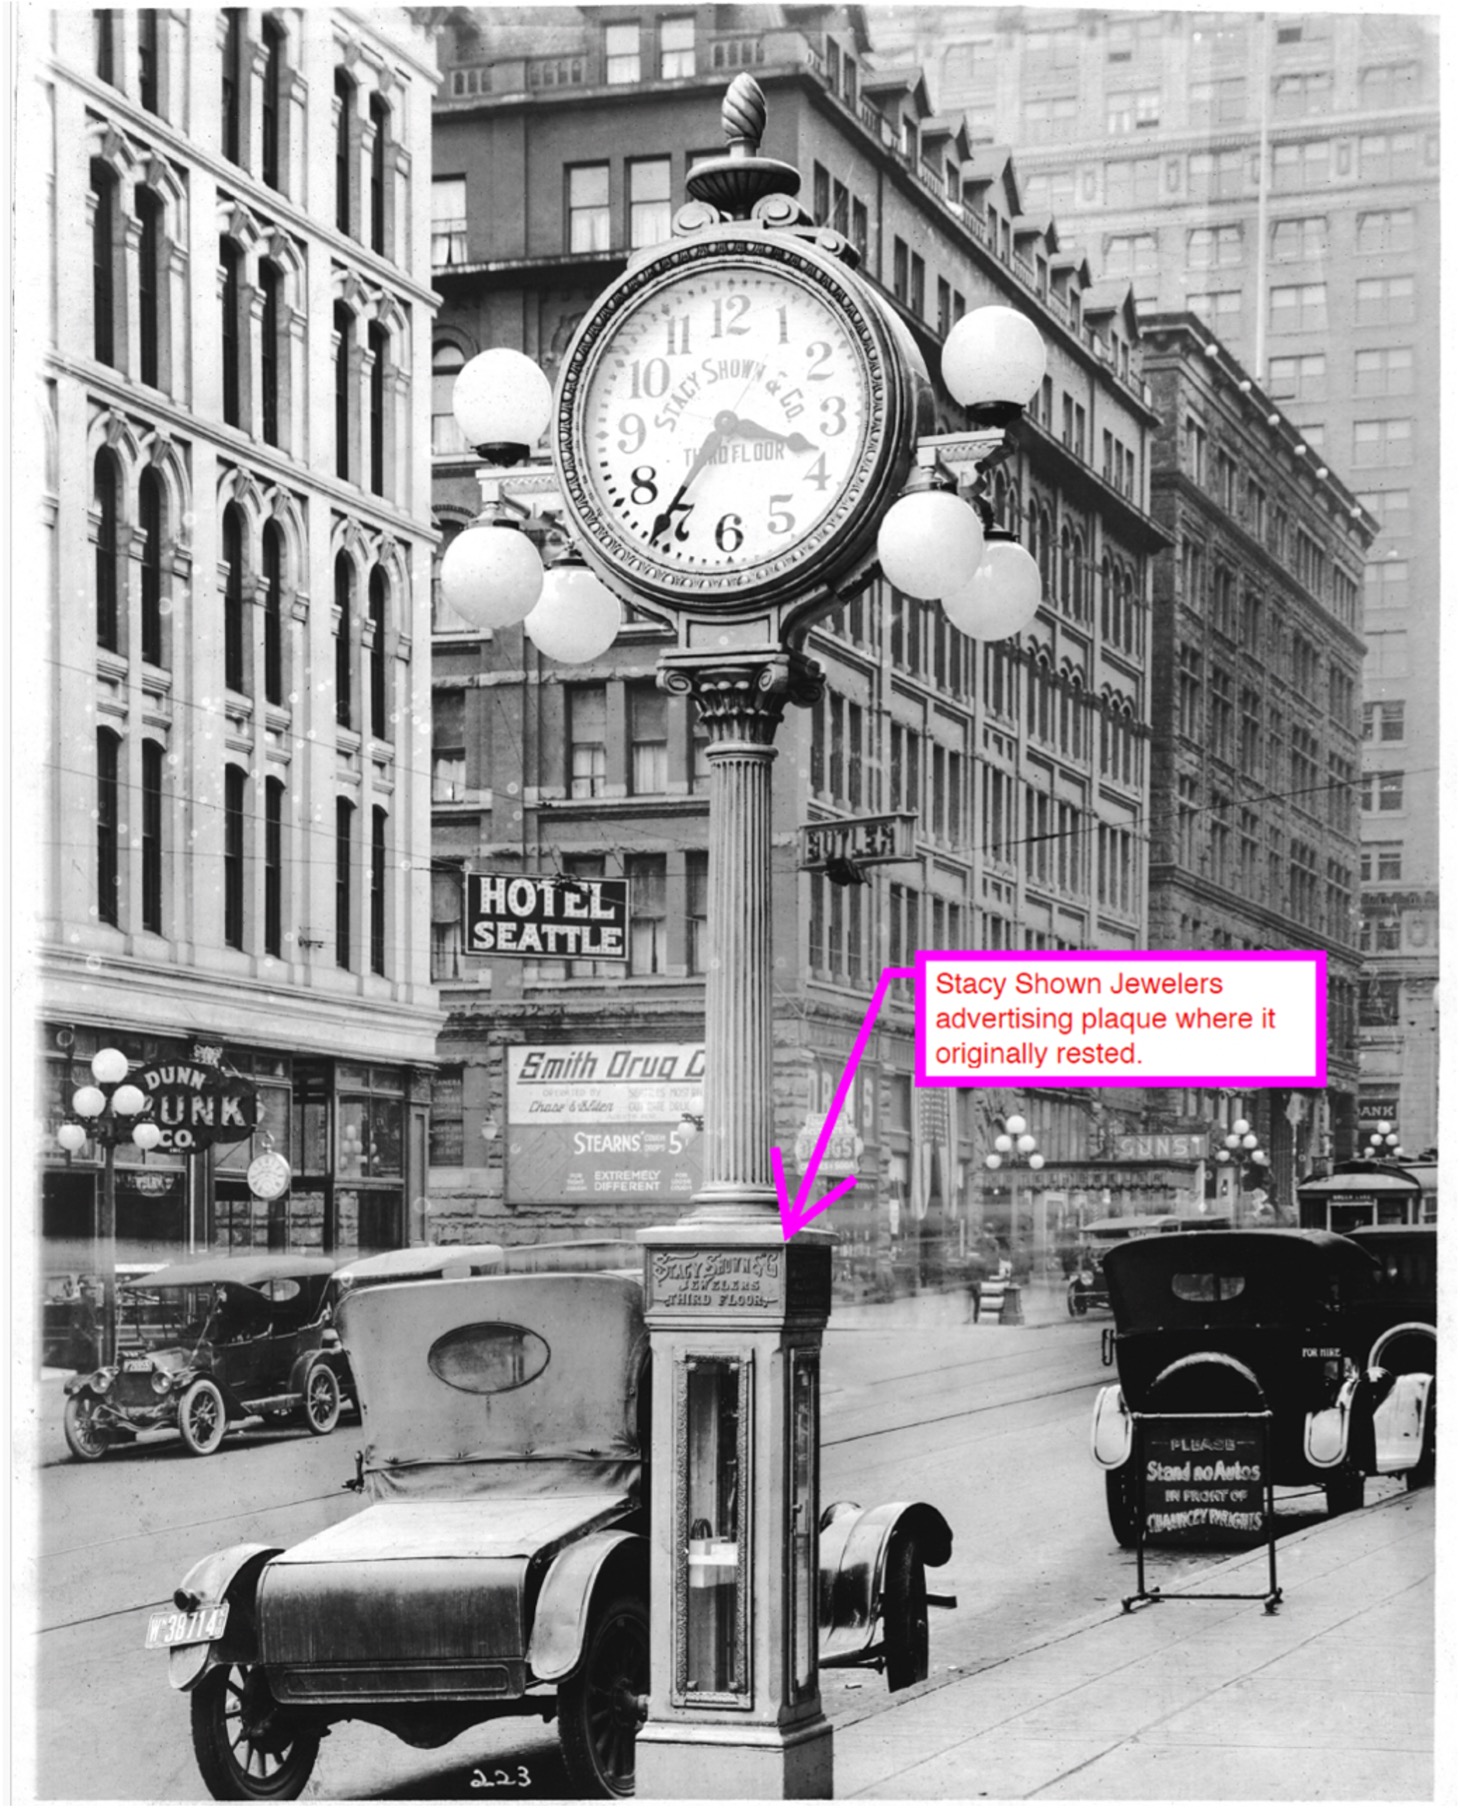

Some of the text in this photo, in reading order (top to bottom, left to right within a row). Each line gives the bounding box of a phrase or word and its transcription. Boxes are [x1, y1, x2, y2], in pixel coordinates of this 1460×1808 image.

[710, 294, 752, 338] 12
[776, 304, 790, 345] 1
[665, 314, 692, 355] 11
[629, 357, 670, 399] 10
[805, 341, 834, 381] 2
[820, 396, 847, 436] 3
[617, 413, 647, 454] 9
[732, 441, 784, 463] FLOOR
[630, 465, 658, 505] 8
[802, 451, 828, 491] 4
[669, 503, 695, 541] 7
[767, 493, 796, 534] 5
[715, 513, 744, 552] 6
[480, 877, 615, 920] HOTEL
[473, 921, 623, 955] SEATTLE
[144, 1066, 207, 1091] DUNN
[518, 1051, 599, 1079] Smith
[606, 1050, 679, 1081] Drug
[1357, 1105, 1394, 1116] ANK
[158, 1129, 196, 1148] CO.
[594, 1170, 661, 1180] EXTREMELY
[594, 1181, 661, 1192] DIFFERENT
[666, 1294, 766, 1307] THIRD FLOOR
[679, 1280, 760, 1292] JEWELERS
[1302, 1348, 1318, 1357] FOR
[1170, 1439, 1236, 1451] PLEASE
[1147, 1460, 1261, 1481] Stand no Autos
[1165, 1489, 1248, 1502] IN FRONT OF
